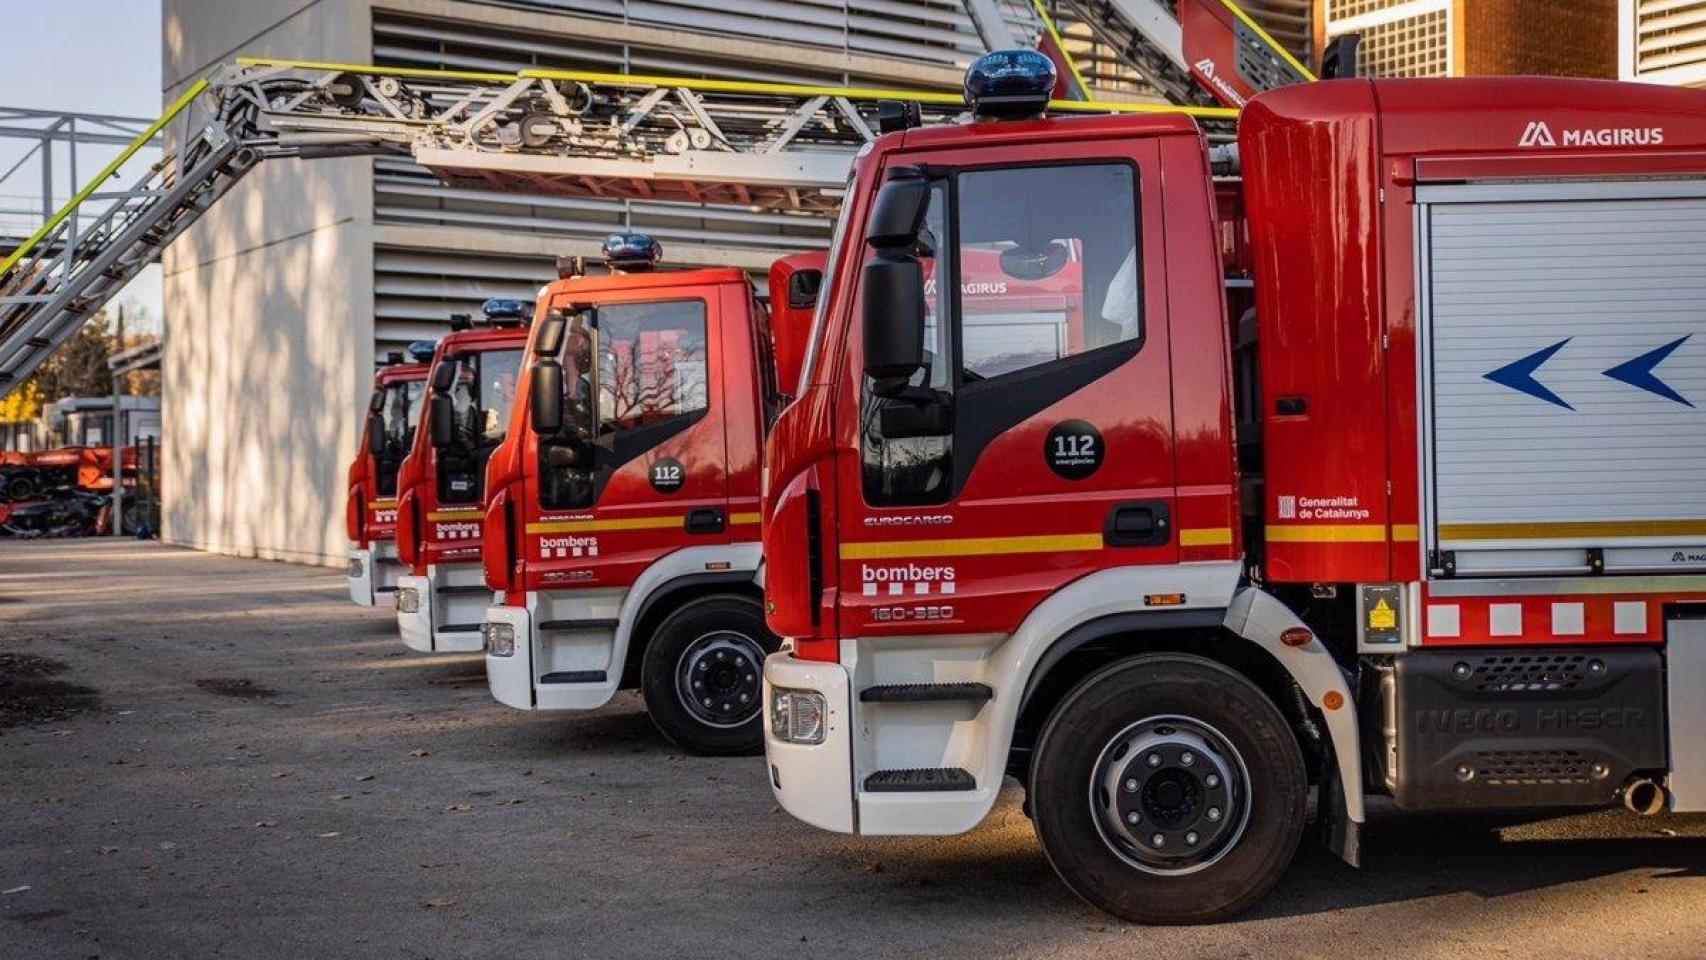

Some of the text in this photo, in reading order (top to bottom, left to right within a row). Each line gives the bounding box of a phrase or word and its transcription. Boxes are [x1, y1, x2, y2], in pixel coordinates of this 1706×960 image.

[1563, 127, 1664, 146] MAGIRUS
[961, 282, 1008, 294] AGIRUS
[1055, 435, 1095, 456] 112
[655, 466, 680, 480] 112
[1299, 497, 1358, 507] Generalitat
[863, 515, 953, 526] EUROCARGO
[1299, 508, 1370, 520] de Catalunya
[540, 535, 598, 548] bombers
[862, 563, 955, 581] bombers
[1416, 708, 1523, 734] IVECO
